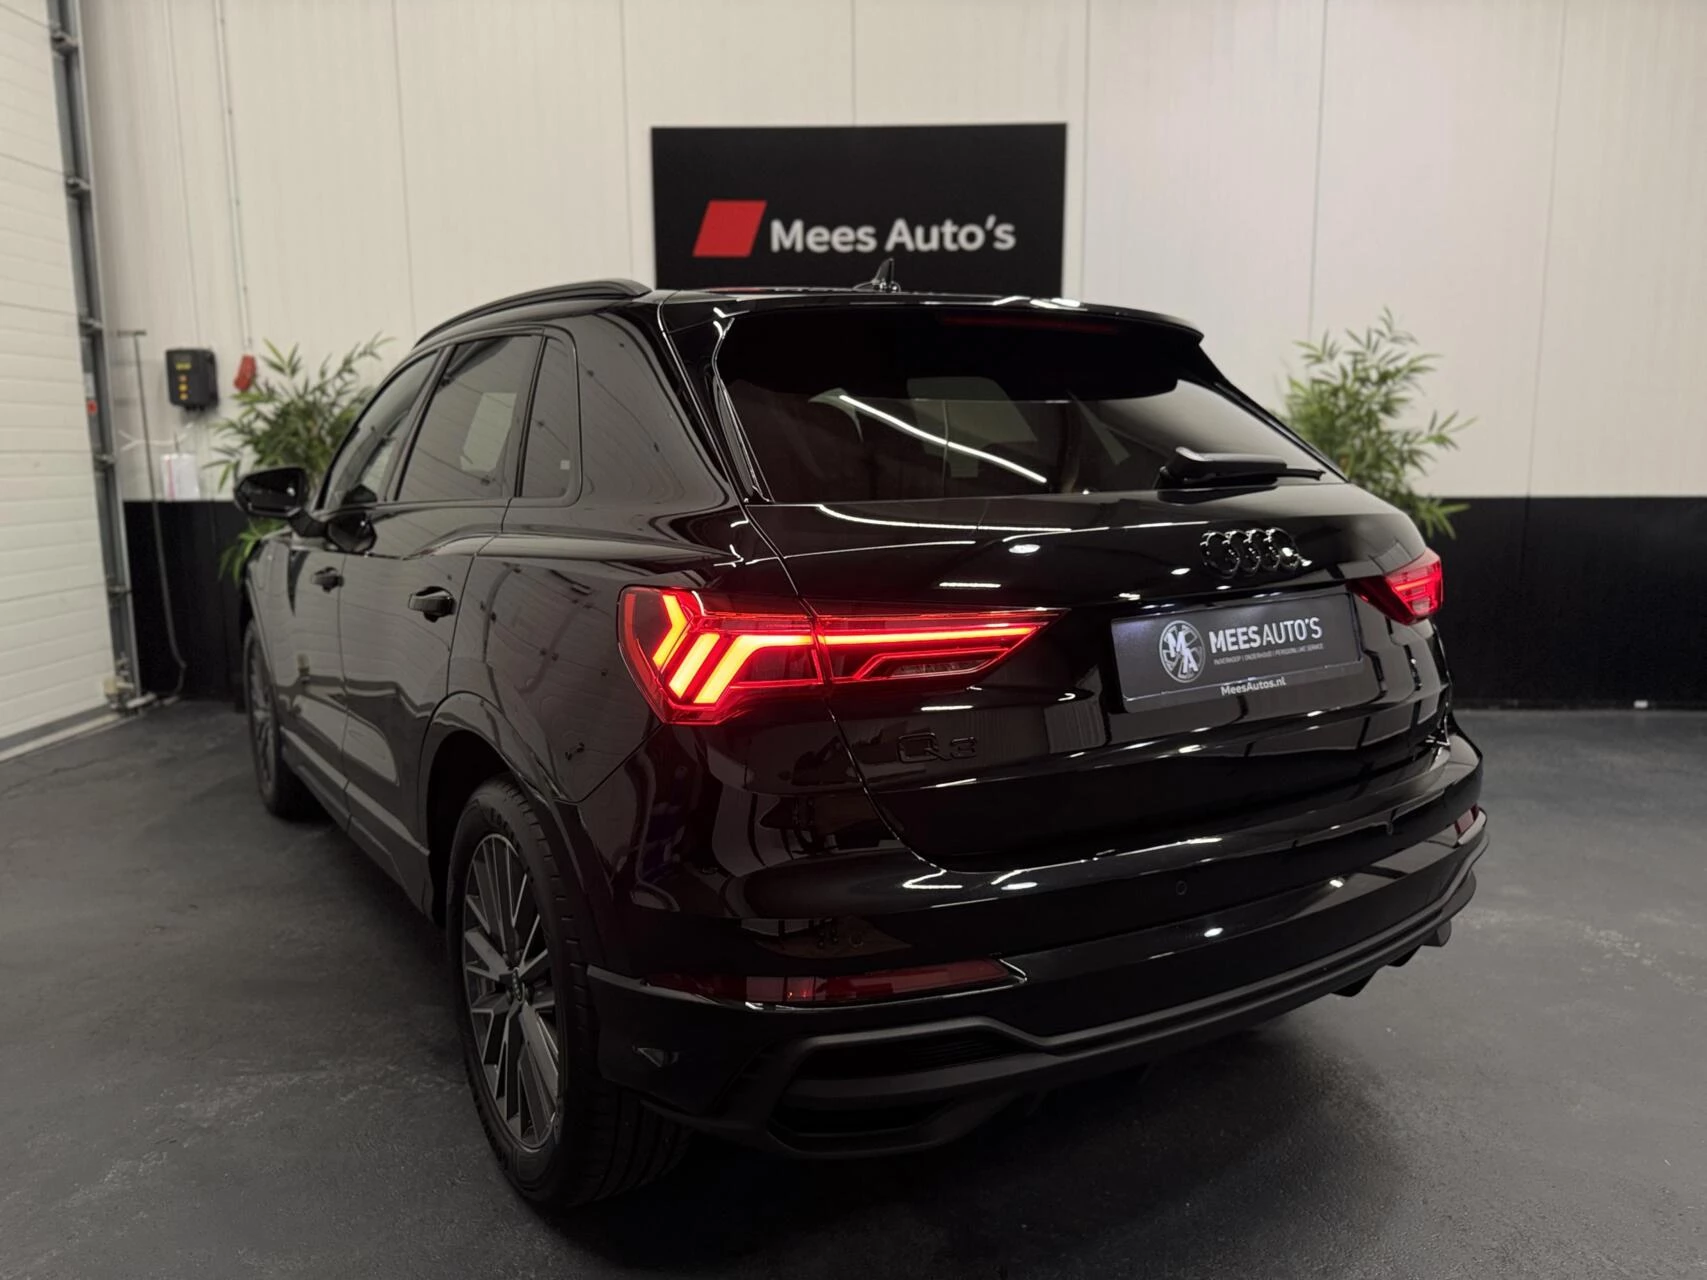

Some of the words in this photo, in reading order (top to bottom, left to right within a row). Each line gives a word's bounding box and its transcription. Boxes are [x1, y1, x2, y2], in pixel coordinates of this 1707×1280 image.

[770, 218, 877, 253] Mees
[885, 214, 1016, 252] Auto's
[1221, 677, 1287, 696] MeesAutos.nl
[897, 731, 977, 764] Q3
